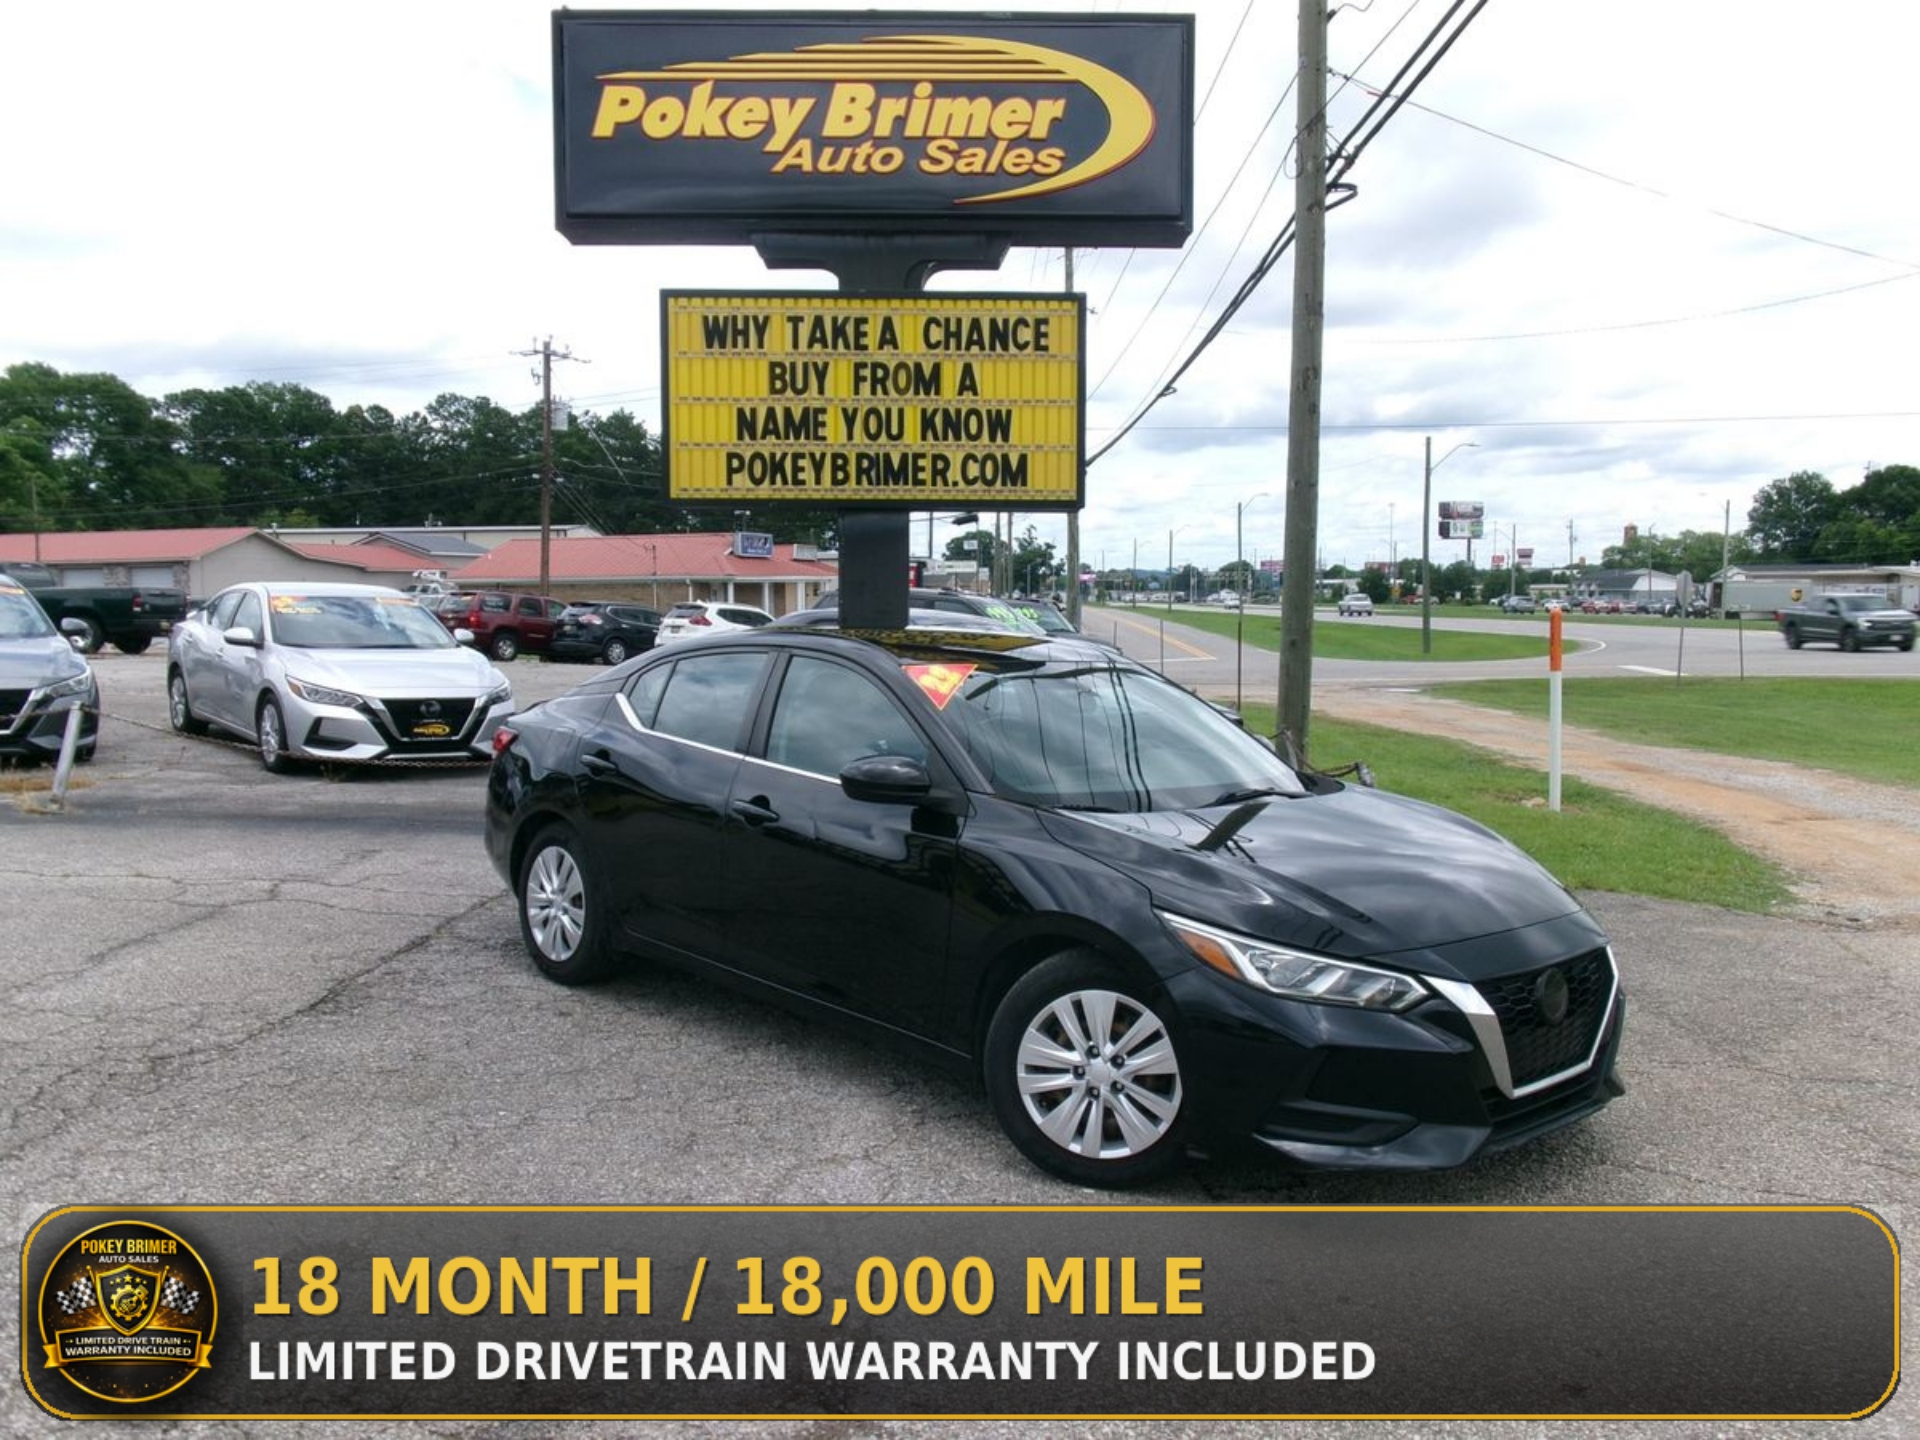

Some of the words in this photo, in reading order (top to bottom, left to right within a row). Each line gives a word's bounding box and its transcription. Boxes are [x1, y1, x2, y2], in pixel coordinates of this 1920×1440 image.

[591, 80, 817, 153] Pokey
[821, 81, 1067, 140] Brimer
[771, 140, 906, 174] Auto
[919, 140, 1067, 175] Sales
[702, 314, 770, 350] WHY
[786, 315, 870, 351] TAKE
[877, 316, 900, 351] A
[922, 316, 1051, 352] CHANCE
[768, 361, 830, 396] BUY
[852, 361, 941, 397] FROM
[956, 362, 980, 397] A
[736, 406, 828, 442] NAME
[842, 407, 905, 442] YOU
[919, 407, 1013, 443] KNOW
[725, 451, 1029, 488] POKEYBRIMER.COM
